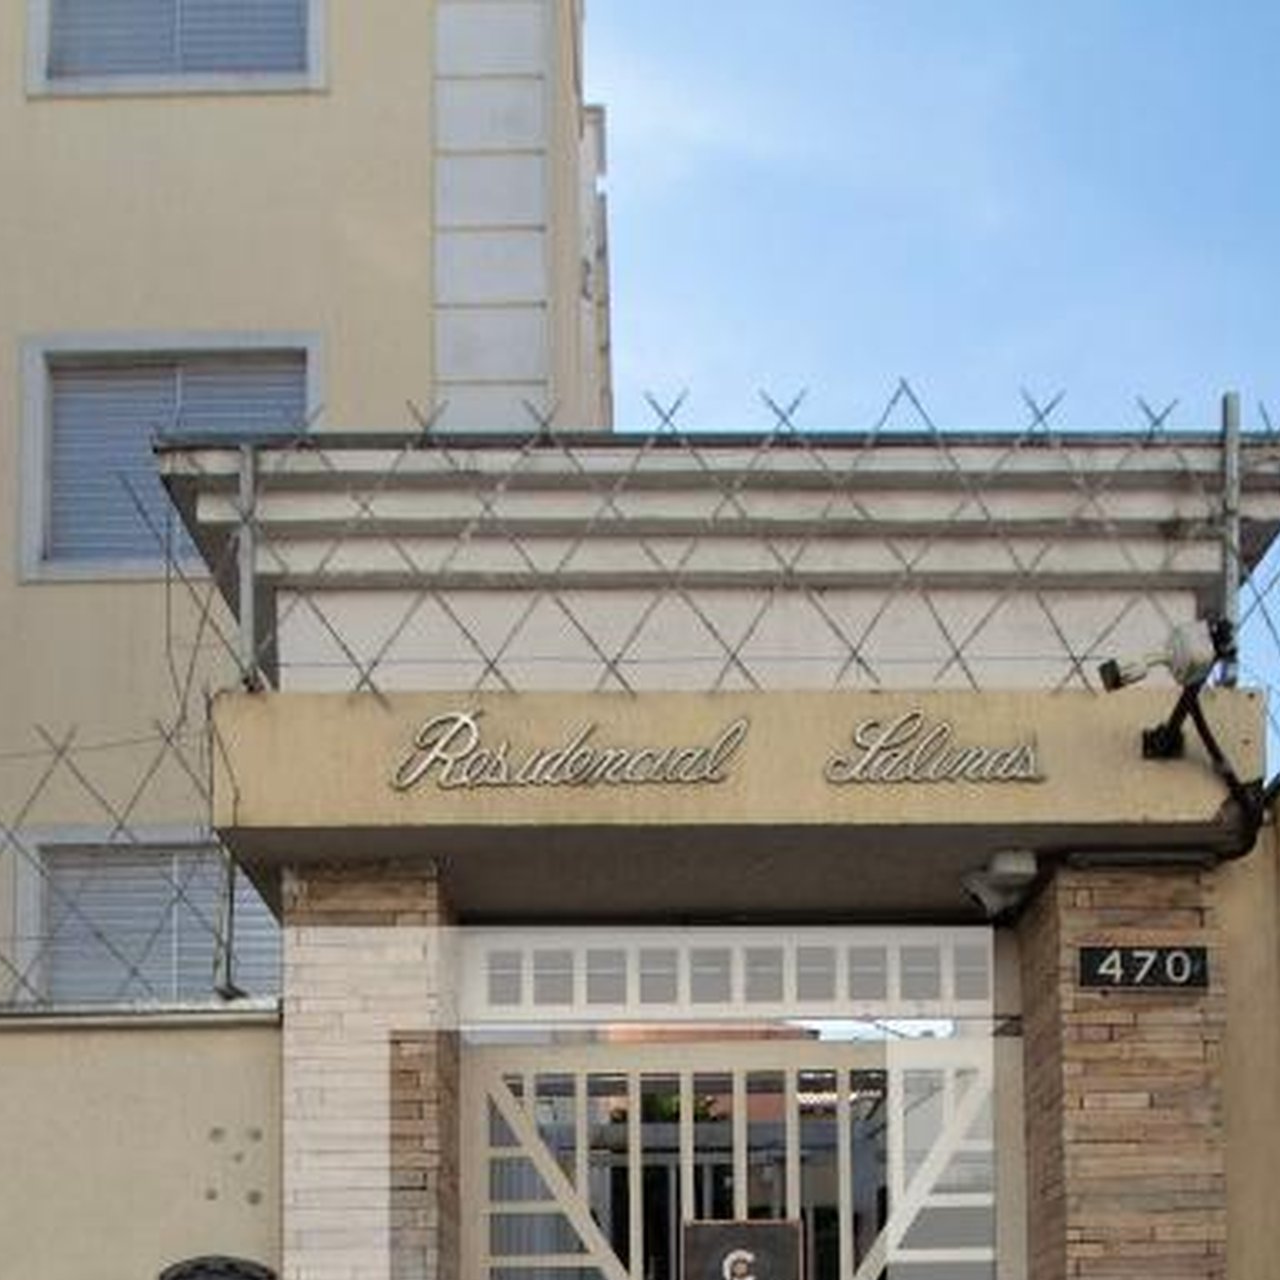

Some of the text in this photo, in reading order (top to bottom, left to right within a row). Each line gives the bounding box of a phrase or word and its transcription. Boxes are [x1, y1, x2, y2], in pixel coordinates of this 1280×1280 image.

[391, 710, 1047, 791] Residencial Salinas
[1097, 950, 1192, 983] 470
